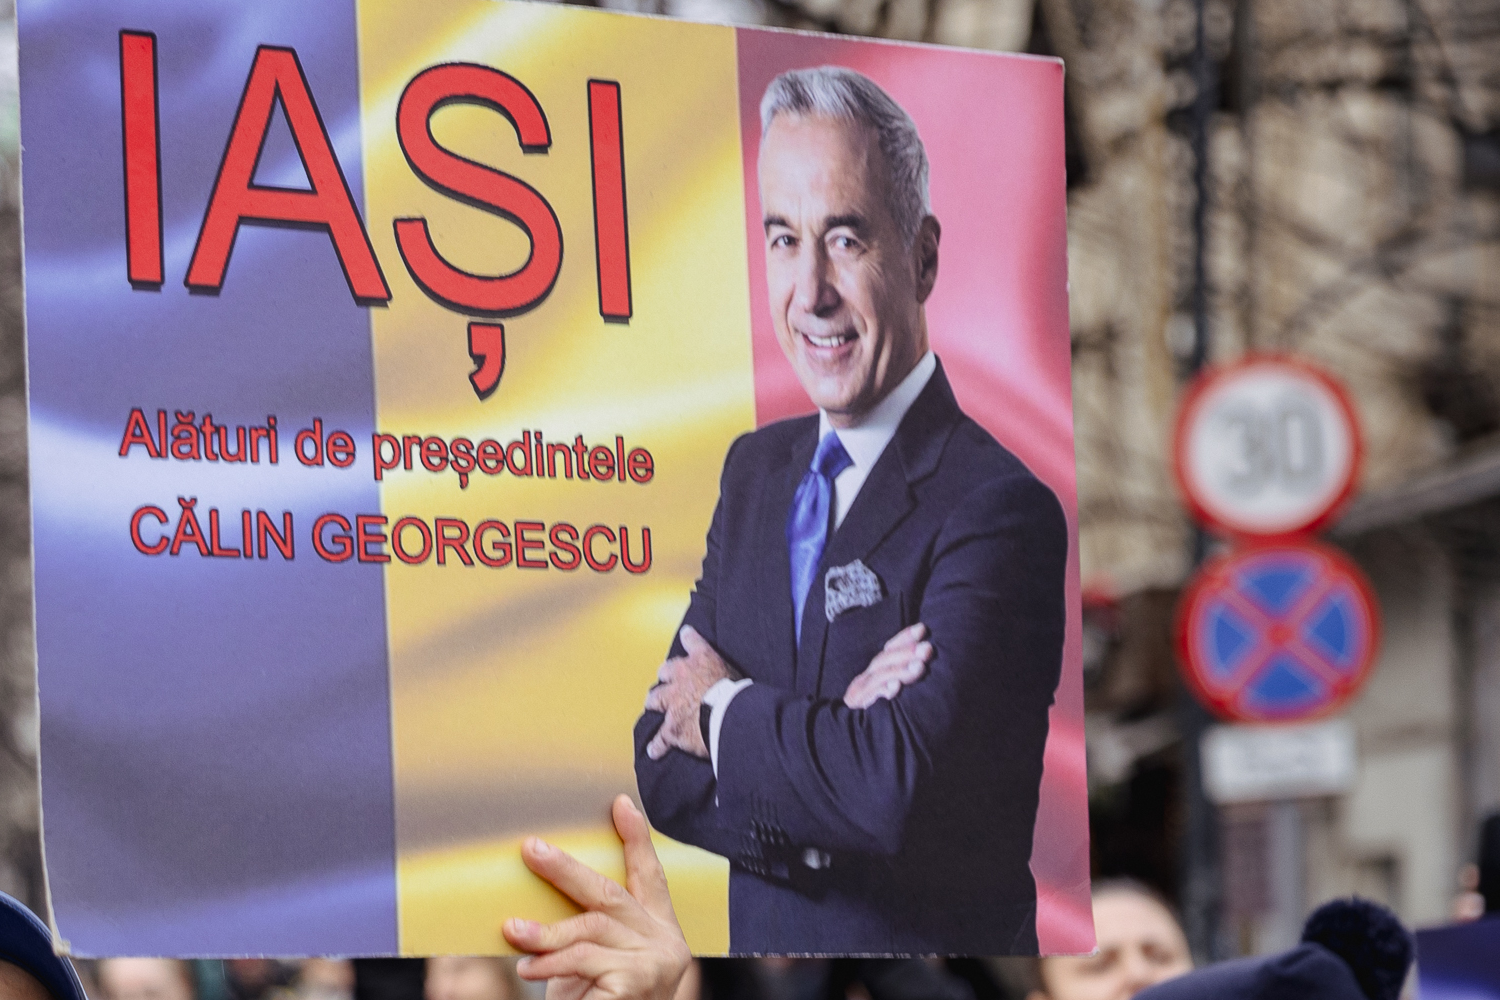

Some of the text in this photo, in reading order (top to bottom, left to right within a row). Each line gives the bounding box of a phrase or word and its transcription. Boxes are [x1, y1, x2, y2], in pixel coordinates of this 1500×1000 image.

[118, 29, 633, 400] IAȘI
[119, 407, 655, 489] Alături de președintele
[1220, 400, 1330, 498] 30
[129, 497, 652, 574] CĂLIN GEORGESCU
